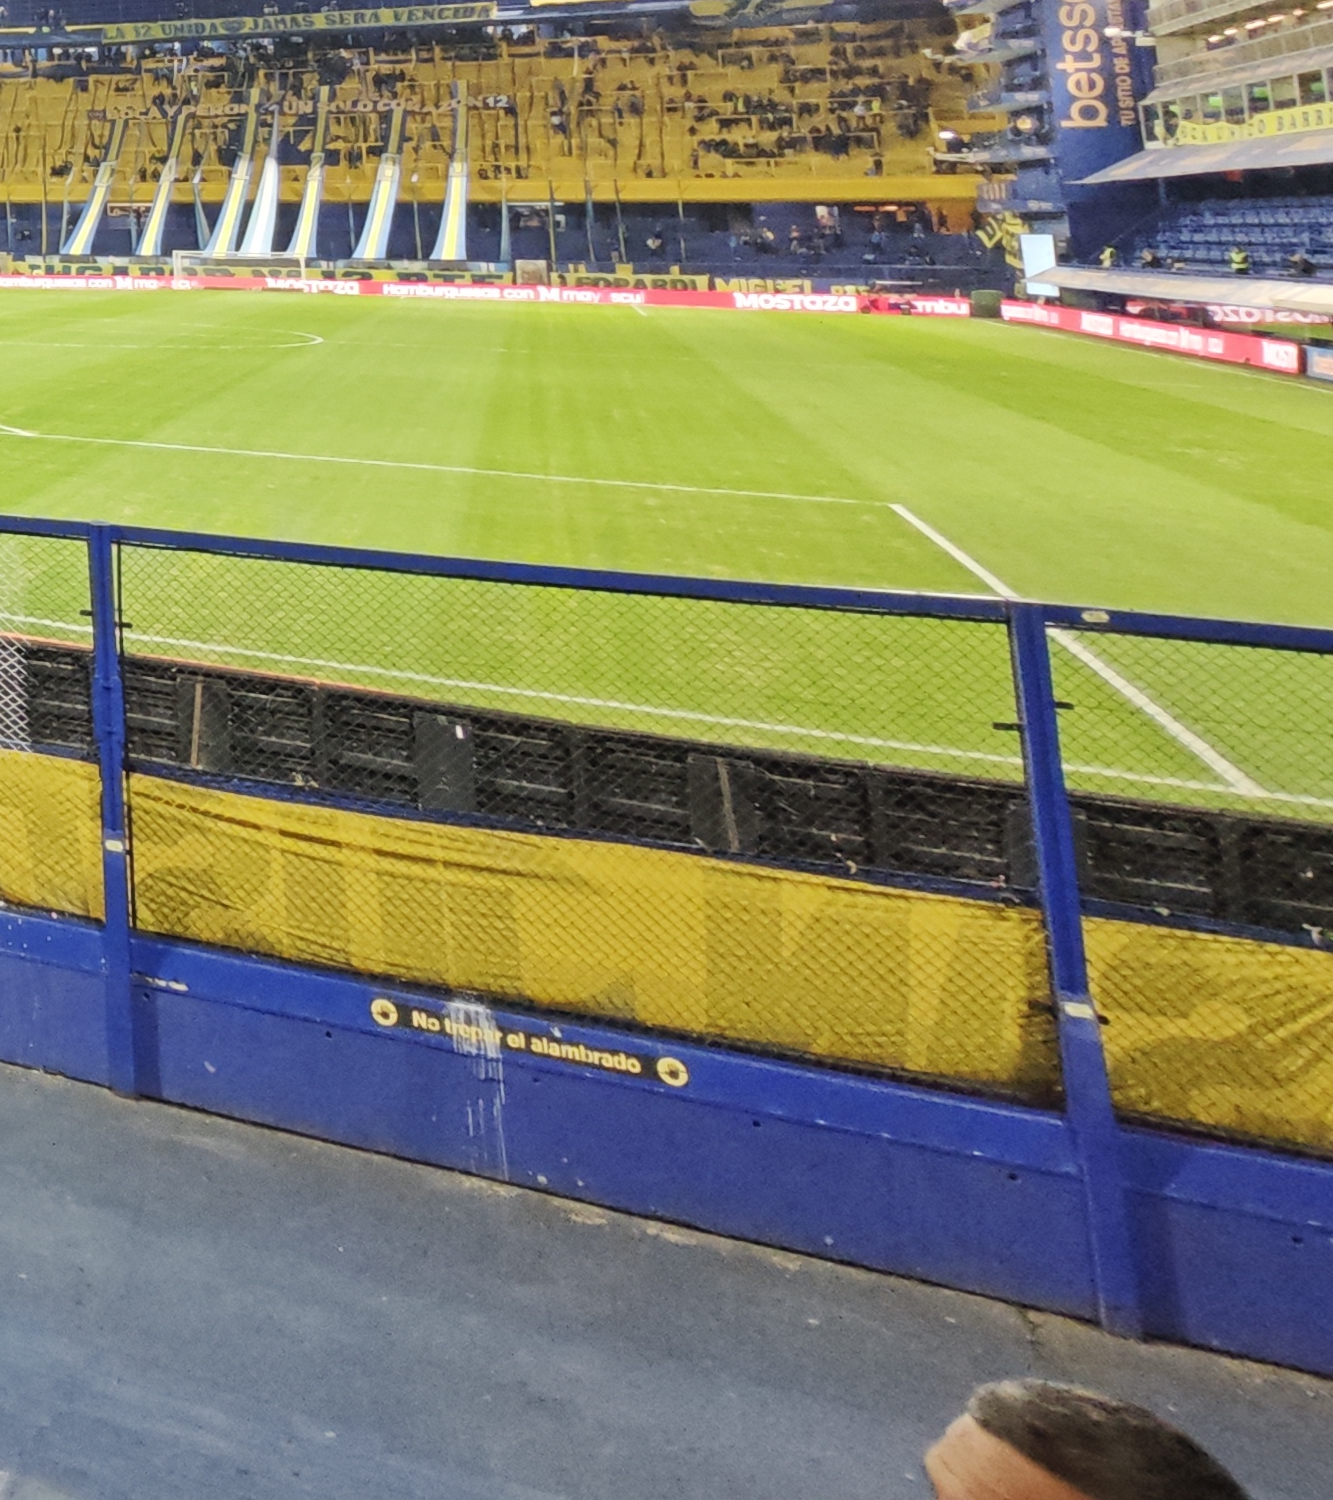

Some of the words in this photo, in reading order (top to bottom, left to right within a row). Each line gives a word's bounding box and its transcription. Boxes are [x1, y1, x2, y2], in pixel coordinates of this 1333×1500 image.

[104, 26, 126, 42] LA
[133, 25, 152, 38] 12
[161, 21, 219, 38] UNIDA
[248, 15, 316, 32] JAMAS
[324, 10, 382, 27] SERA
[393, 4, 492, 24] VENCIDA
[1114, 57, 1132, 74] DE
[485, 94, 510, 109] 12
[1116, 76, 1136, 110] SITIO
[1119, 112, 1136, 127] TU
[382, 283, 502, 299] Hamburguesas
[502, 288, 535, 300] con
[411, 1009, 440, 1033] No
[445, 1020, 502, 1045] trepar
[506, 1030, 526, 1049] el
[530, 1035, 642, 1074] alambrado
